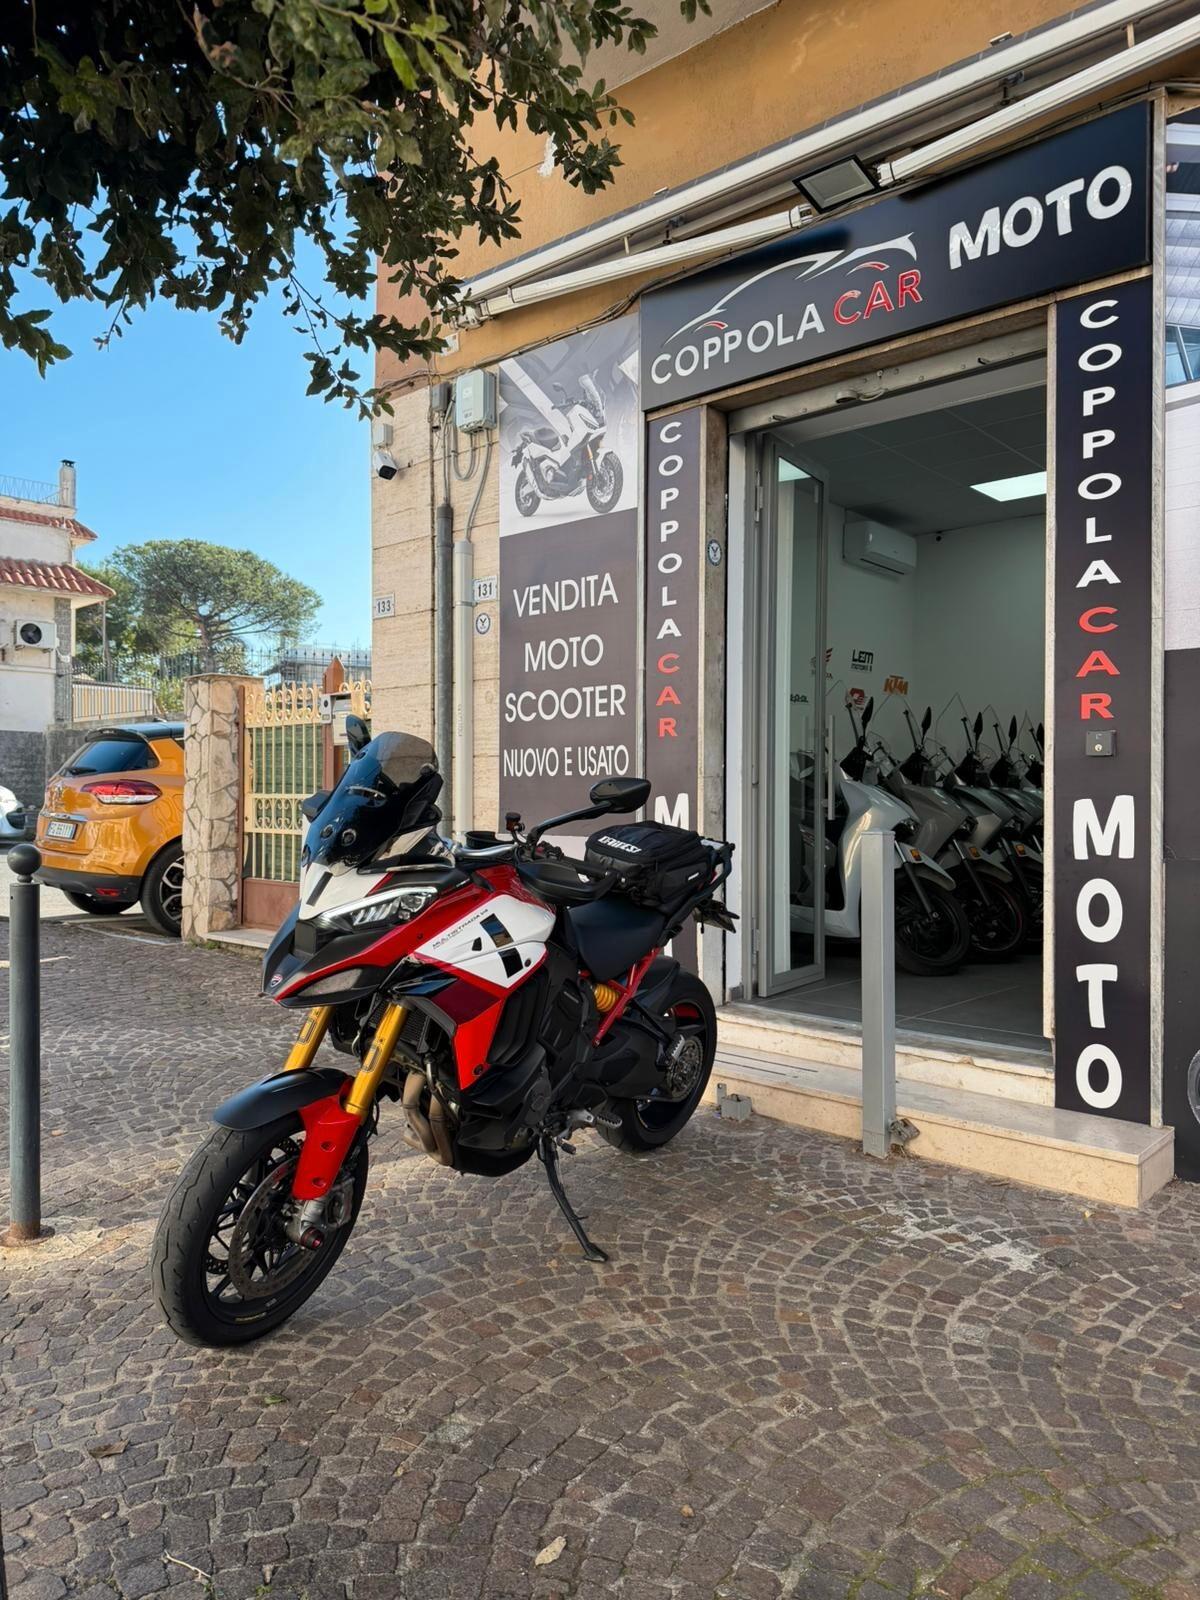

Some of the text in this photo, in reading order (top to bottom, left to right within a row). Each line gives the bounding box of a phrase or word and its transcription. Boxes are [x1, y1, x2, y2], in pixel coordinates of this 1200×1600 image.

[651, 165, 1134, 384] COPPOLA CAR MOTO
[377, 599, 391, 613] 133
[478, 582, 492, 597] 131
[512, 571, 619, 618] VENDITA
[524, 633, 604, 673] MOTO
[852, 649, 874, 664] LEM
[504, 683, 627, 723] SCOOTER
[503, 744, 630, 778] NUOVO E USATO
[1072, 794, 1135, 1110] MOTO
